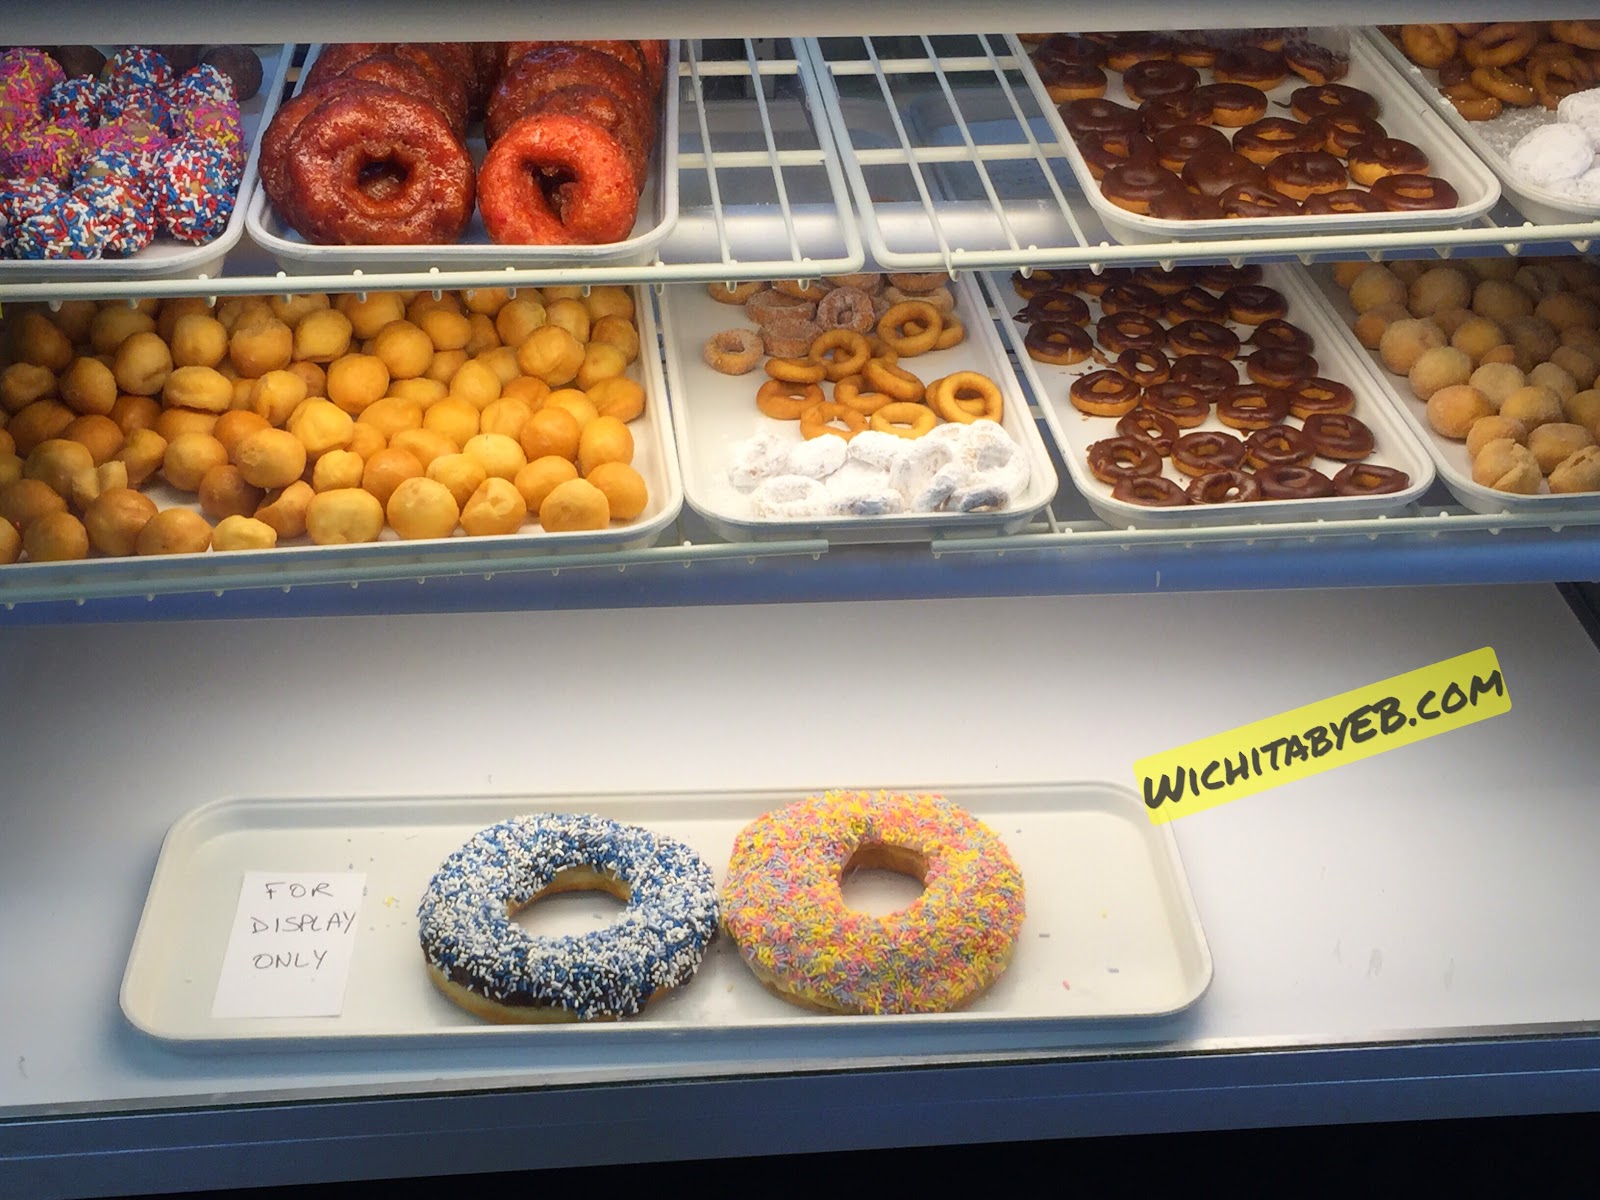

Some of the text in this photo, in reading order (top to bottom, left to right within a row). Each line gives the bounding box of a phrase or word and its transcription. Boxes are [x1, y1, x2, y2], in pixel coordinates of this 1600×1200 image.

[265, 881, 334, 900] FOR
[250, 911, 357, 934] DISPLAY
[252, 949, 328, 970] ONLY
